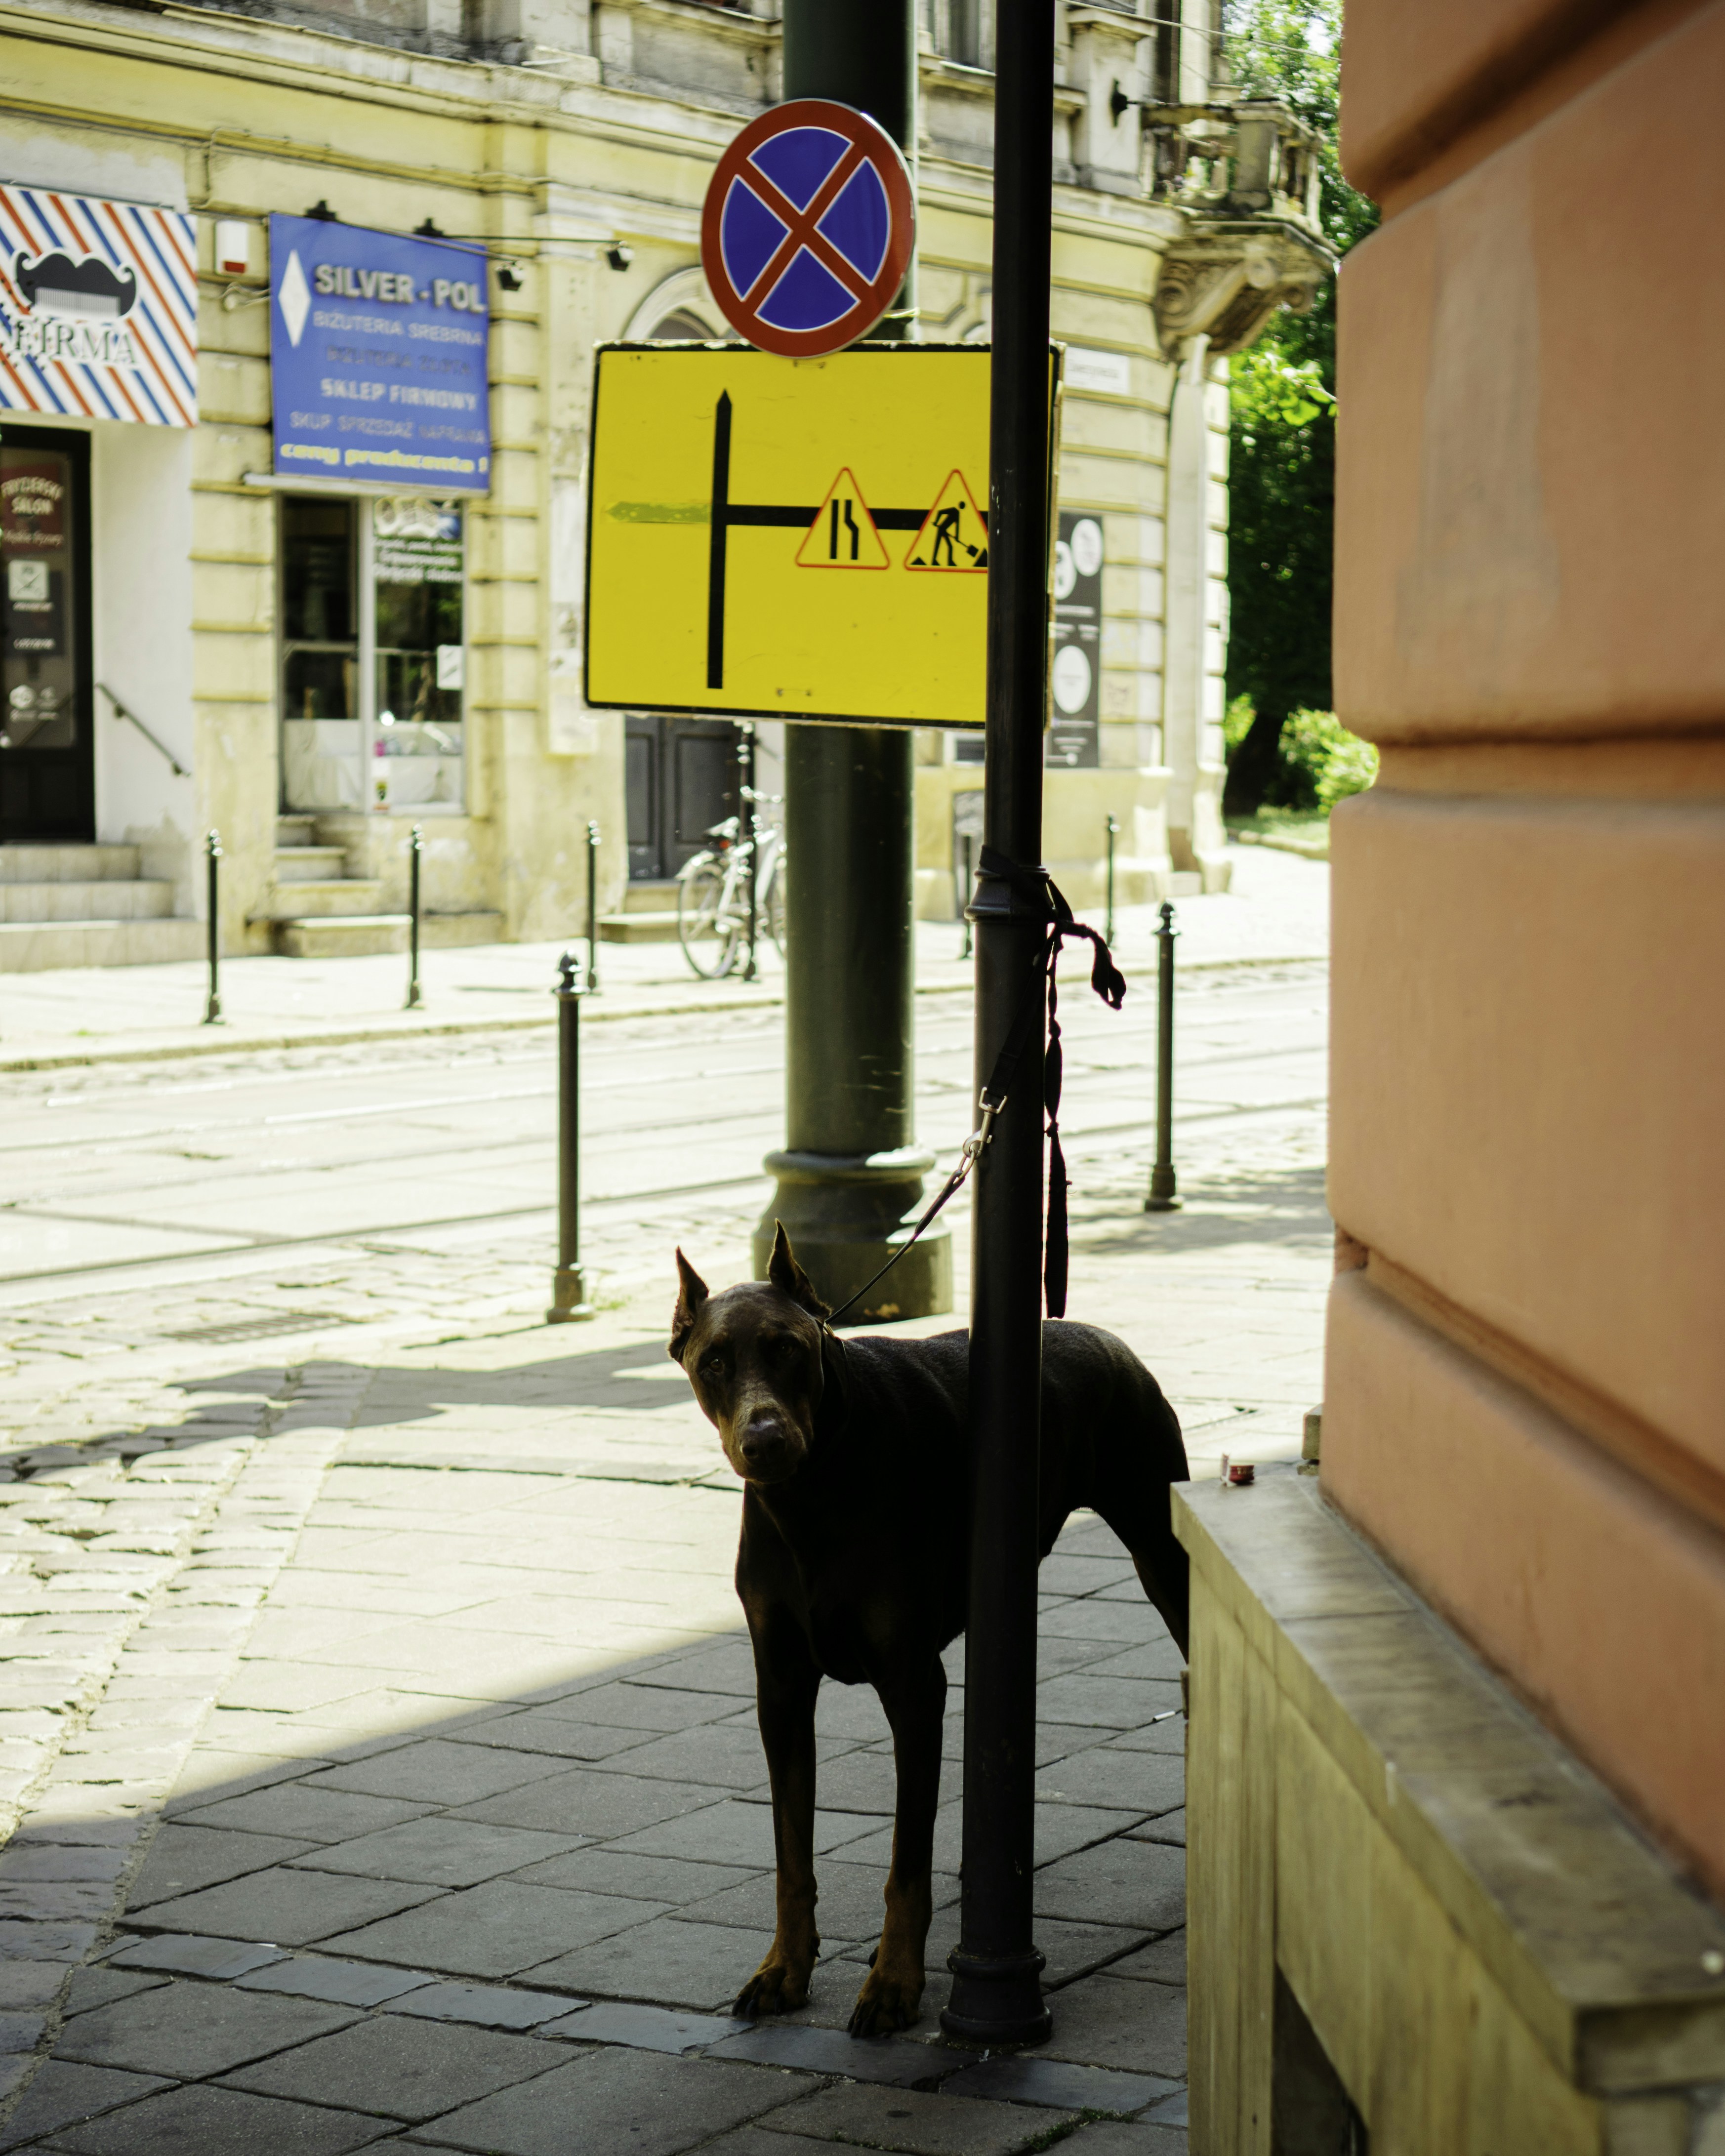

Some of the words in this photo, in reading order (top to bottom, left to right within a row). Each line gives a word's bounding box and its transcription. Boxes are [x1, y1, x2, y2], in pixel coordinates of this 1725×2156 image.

[315, 264, 414, 303] SILVER
[433, 279, 487, 313] POL
[13, 319, 140, 364] FIRMA
[313, 310, 404, 335] BIŻUTERIA
[408, 323, 483, 345] SREBRNA
[320, 378, 385, 401] SKLEP
[389, 385, 478, 411] FIRMOWY
[290, 411, 332, 430] SKUP
[338, 415, 414, 439] SPRZEDAŻ
[281, 444, 339, 465] ceny
[344, 449, 475, 474] producenta
